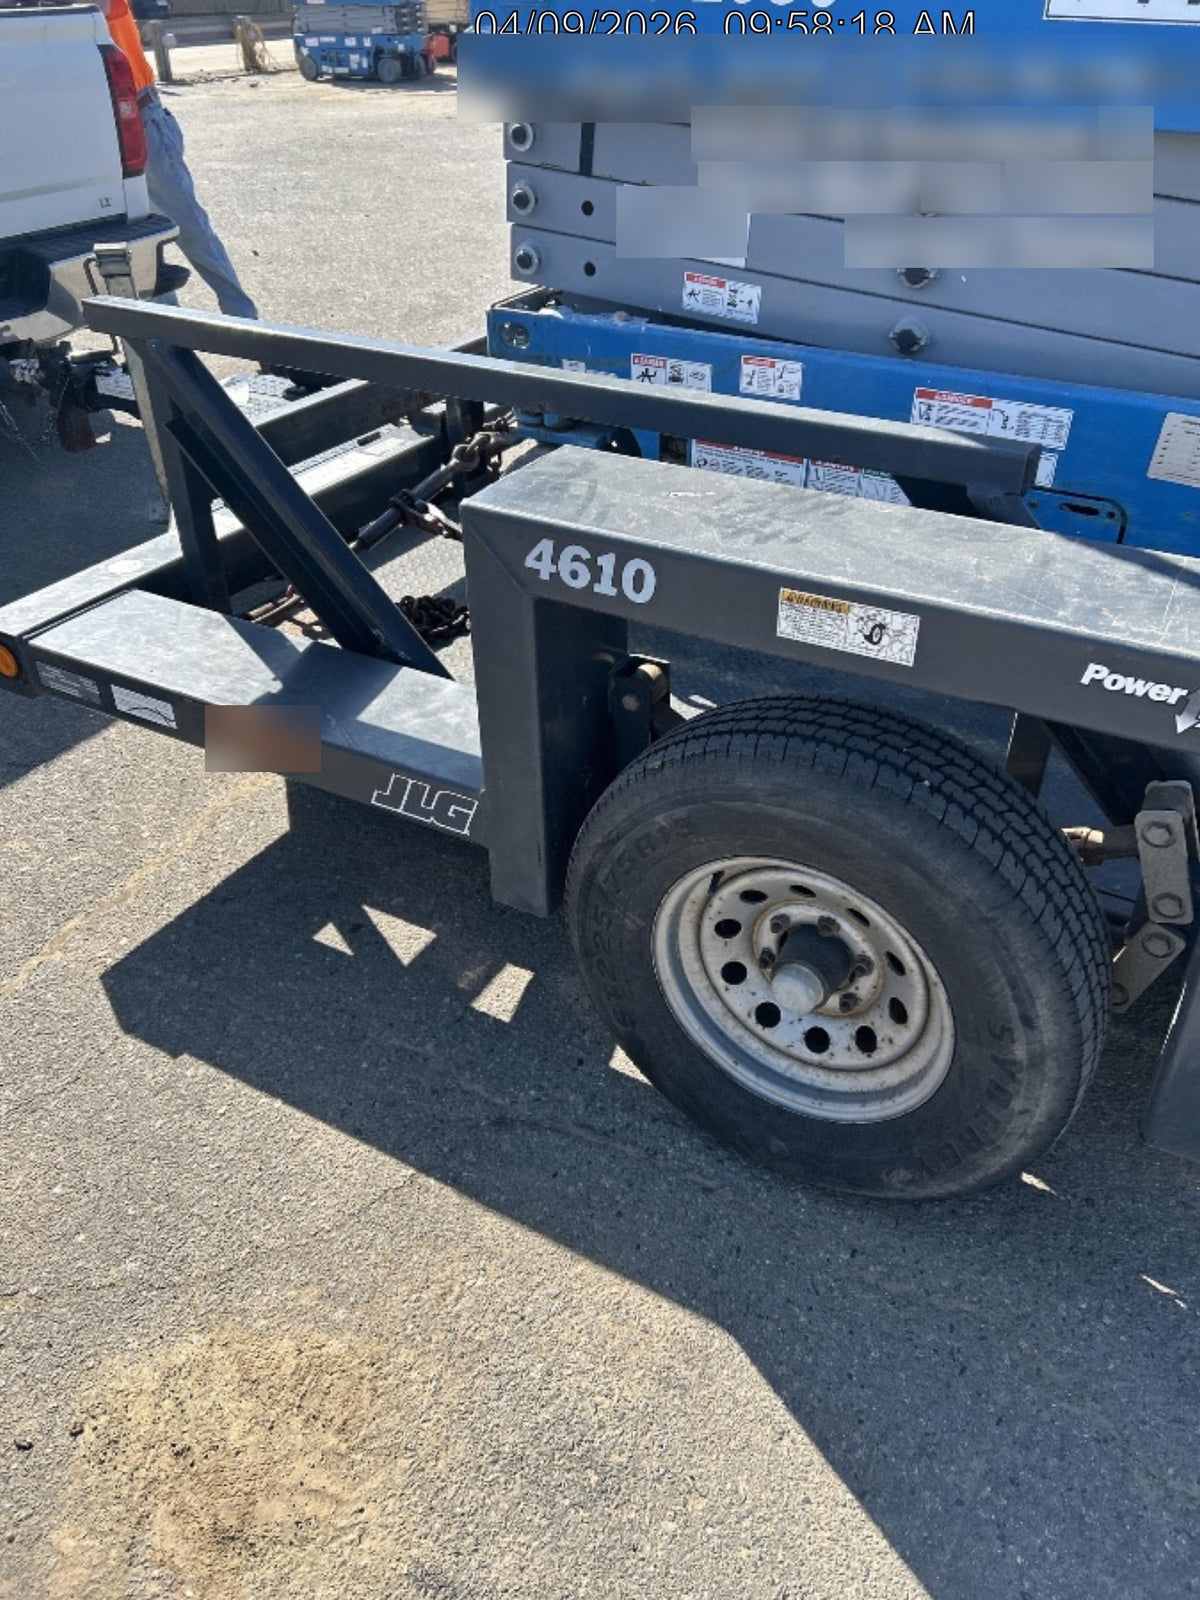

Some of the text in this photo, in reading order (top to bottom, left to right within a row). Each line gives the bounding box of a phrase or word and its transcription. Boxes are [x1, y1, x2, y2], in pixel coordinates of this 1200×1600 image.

[524, 538, 656, 603] 4610
[1080, 662, 1189, 705] Power
[370, 772, 479, 836] JLG
